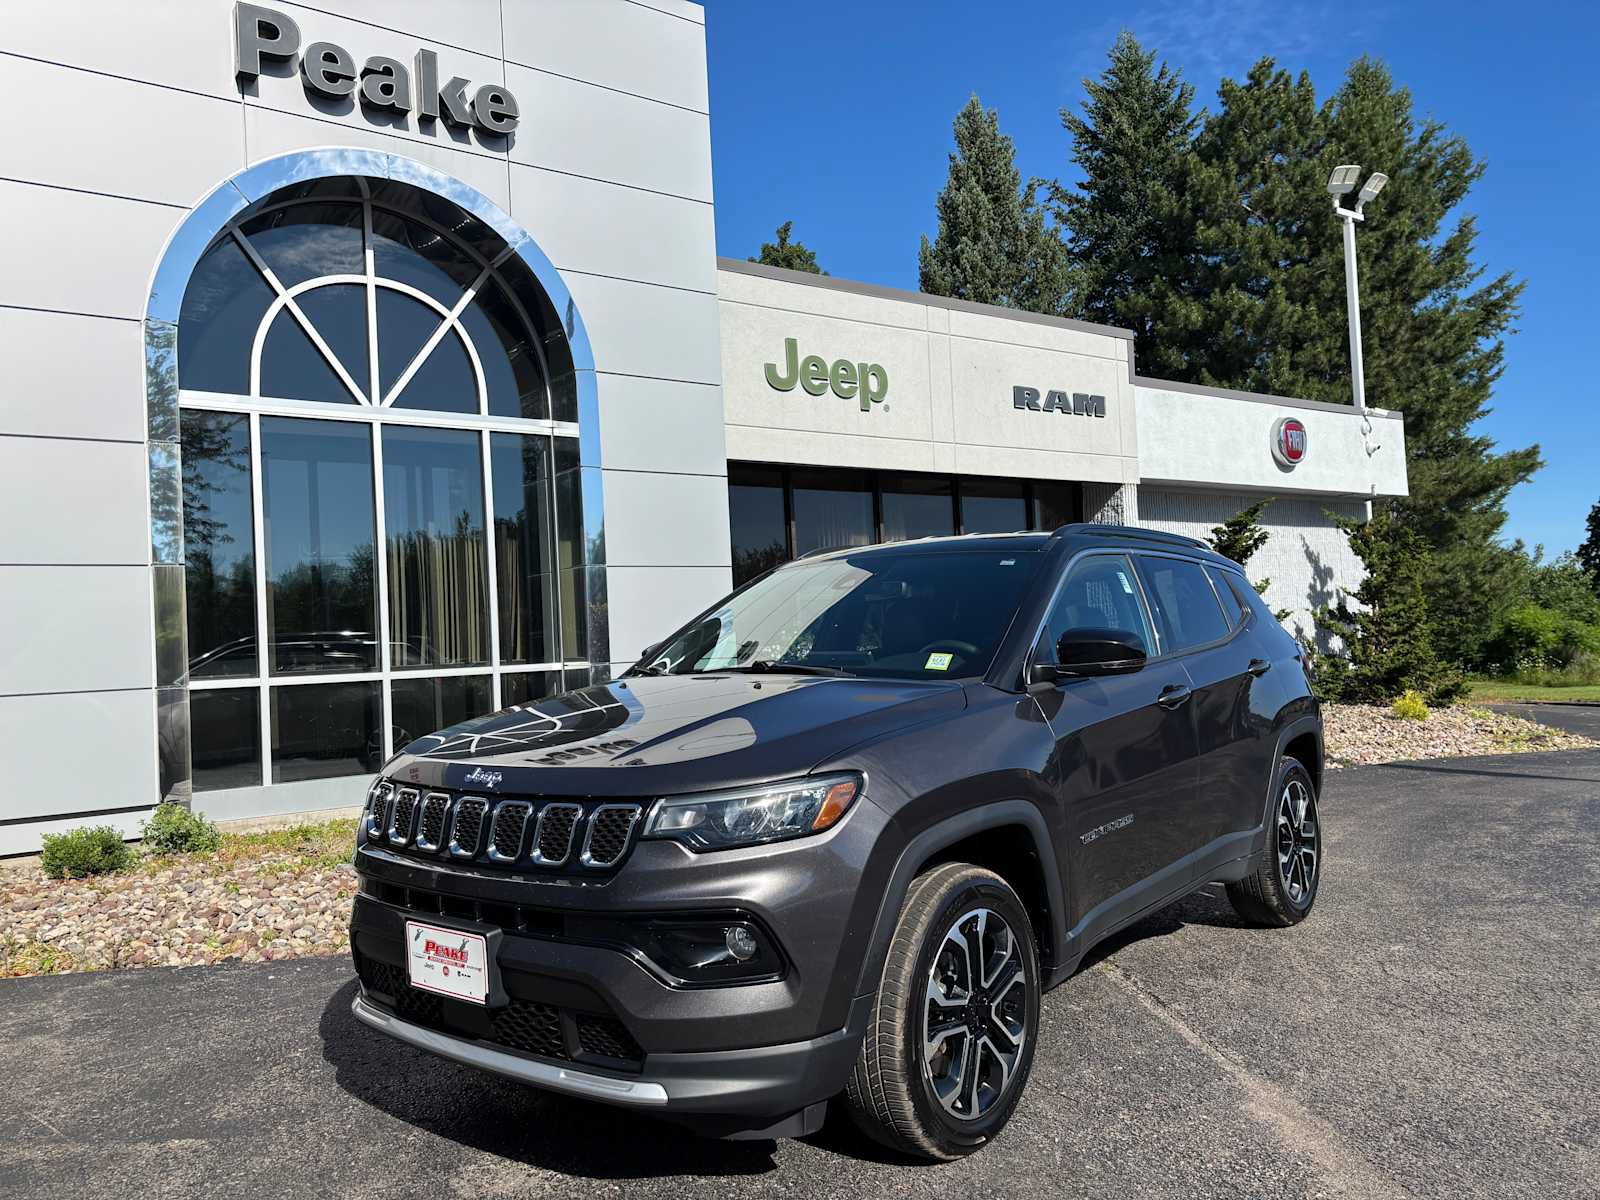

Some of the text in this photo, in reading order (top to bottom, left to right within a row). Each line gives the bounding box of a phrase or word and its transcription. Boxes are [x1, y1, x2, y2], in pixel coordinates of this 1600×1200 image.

[235, 1, 520, 135] Peake
[764, 337, 888, 412] Jeep
[1013, 385, 1106, 418] RAM
[465, 768, 503, 788] Jeep
